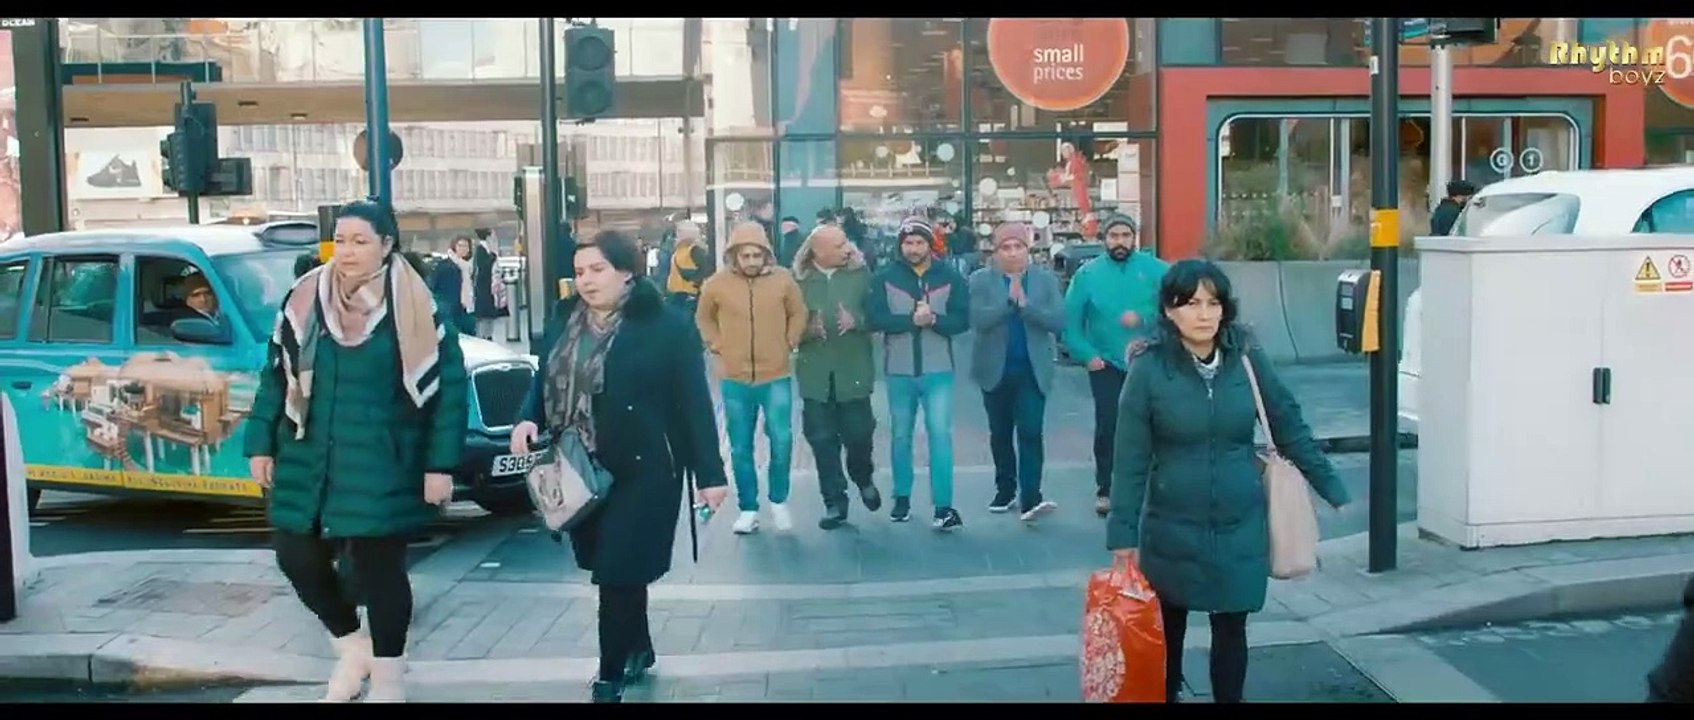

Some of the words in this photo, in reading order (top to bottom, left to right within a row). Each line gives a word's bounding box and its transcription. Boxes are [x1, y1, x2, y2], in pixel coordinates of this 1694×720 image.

[1033, 43, 1084, 63] small
[1665, 34, 1694, 79] 6
[1033, 63, 1084, 84] prices
